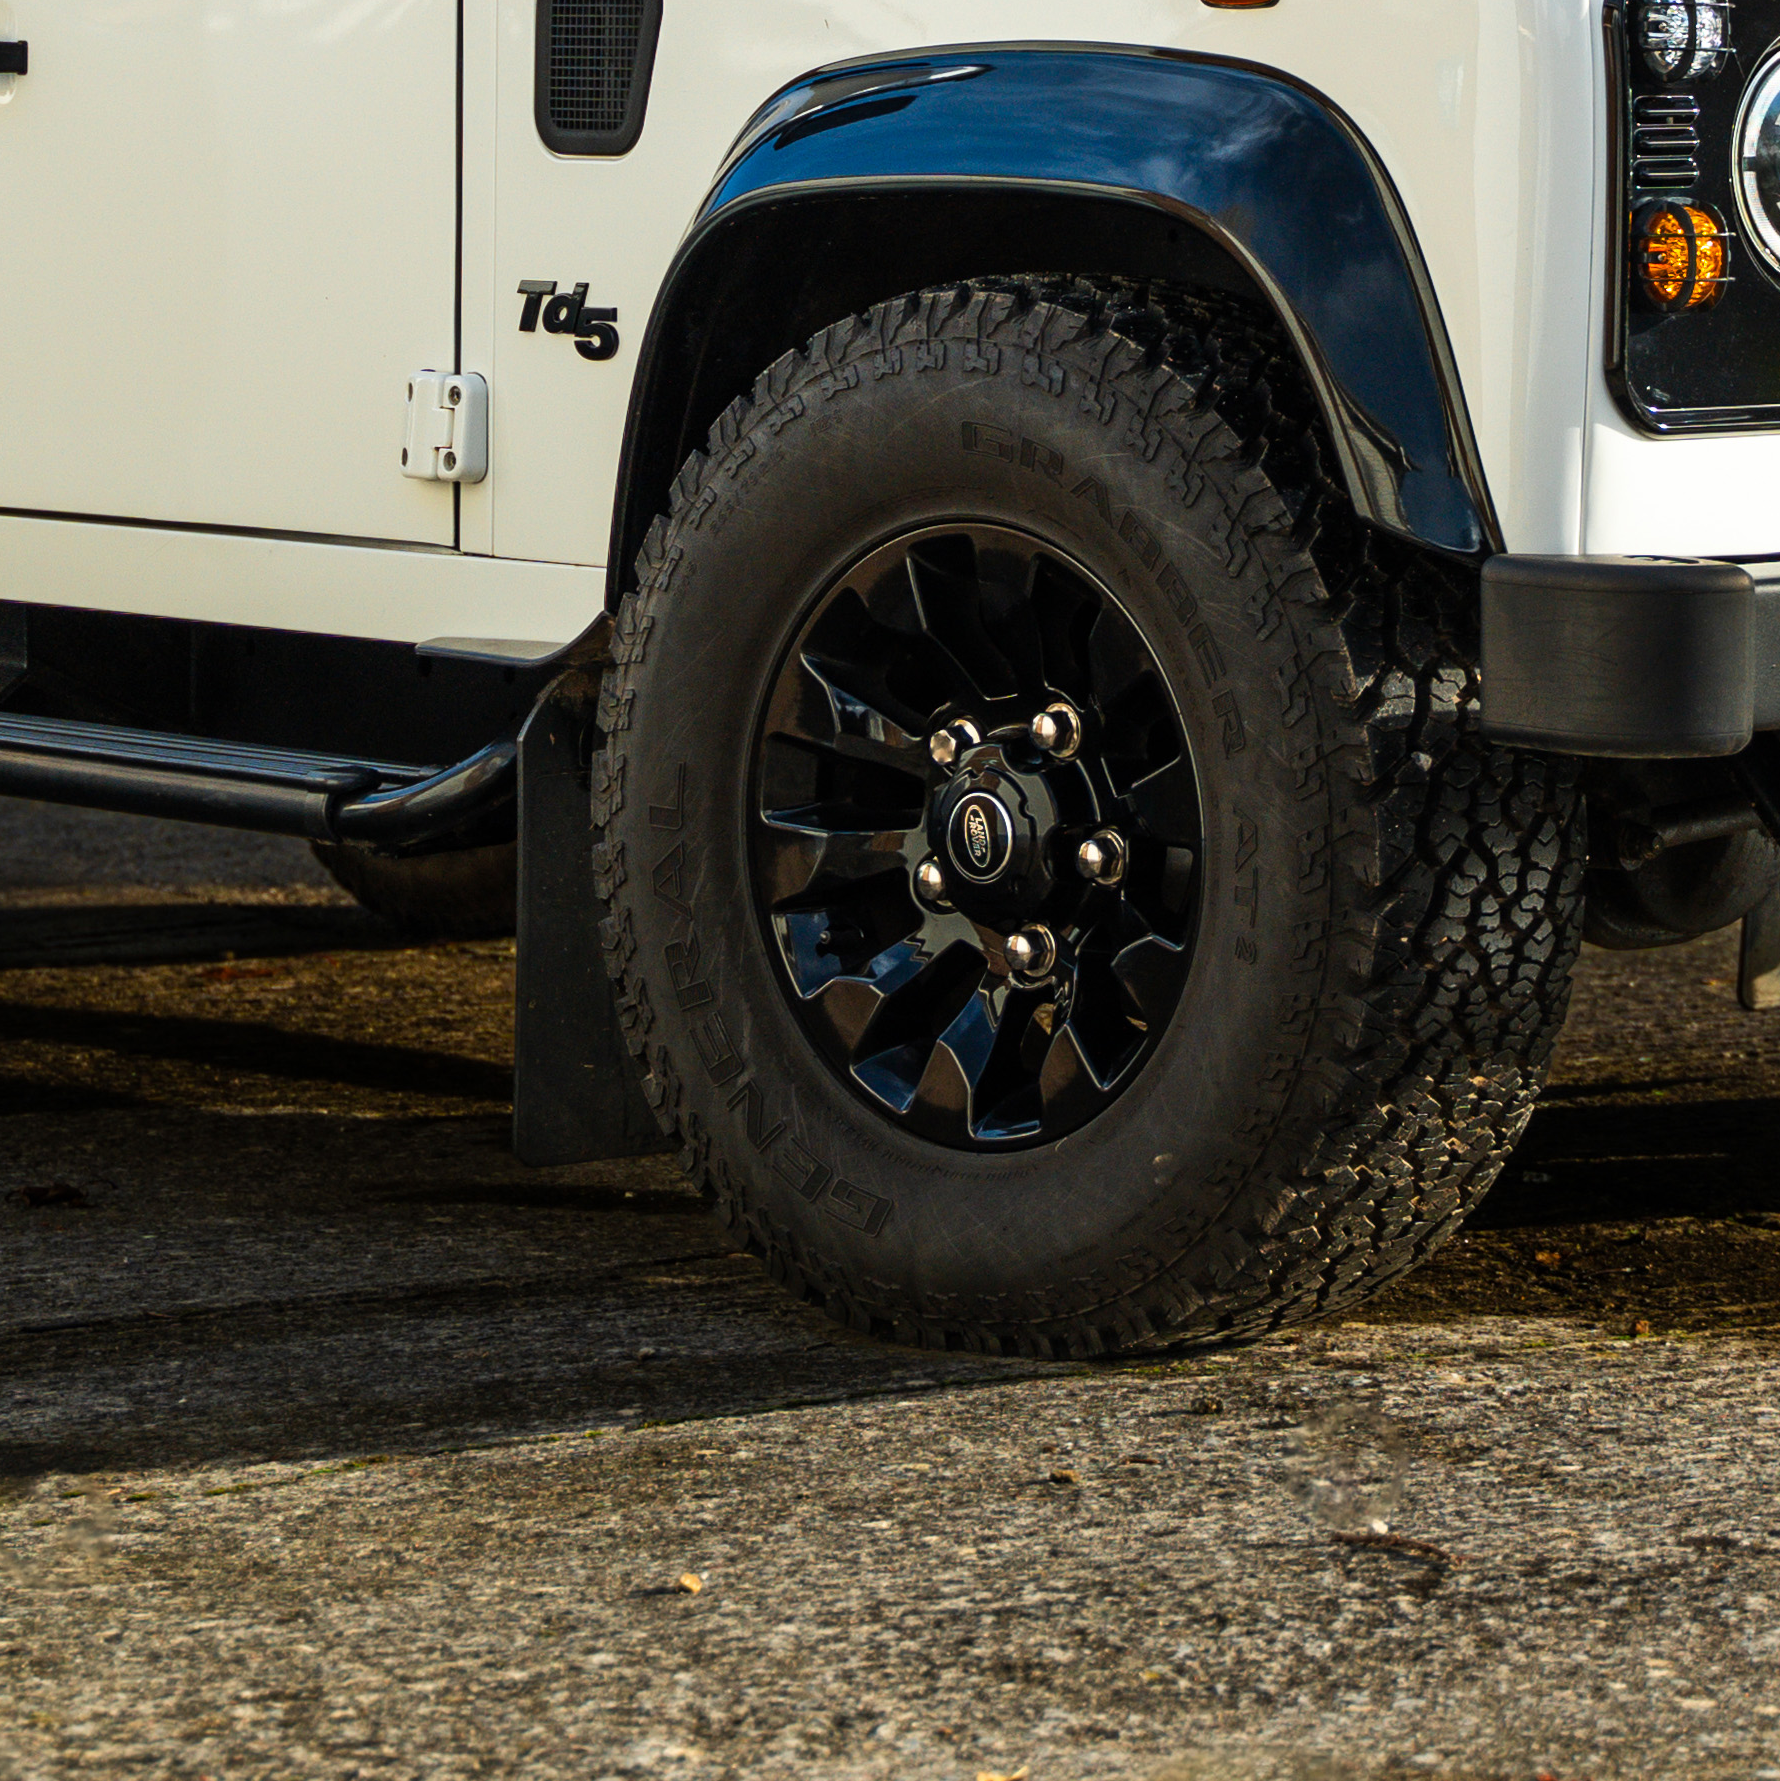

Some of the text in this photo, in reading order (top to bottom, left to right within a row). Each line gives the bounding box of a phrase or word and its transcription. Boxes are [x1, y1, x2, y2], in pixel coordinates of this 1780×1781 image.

[517, 280, 619, 361] Td5
[959, 418, 1247, 757] GRABBER
[650, 761, 895, 1236] GENERAL
